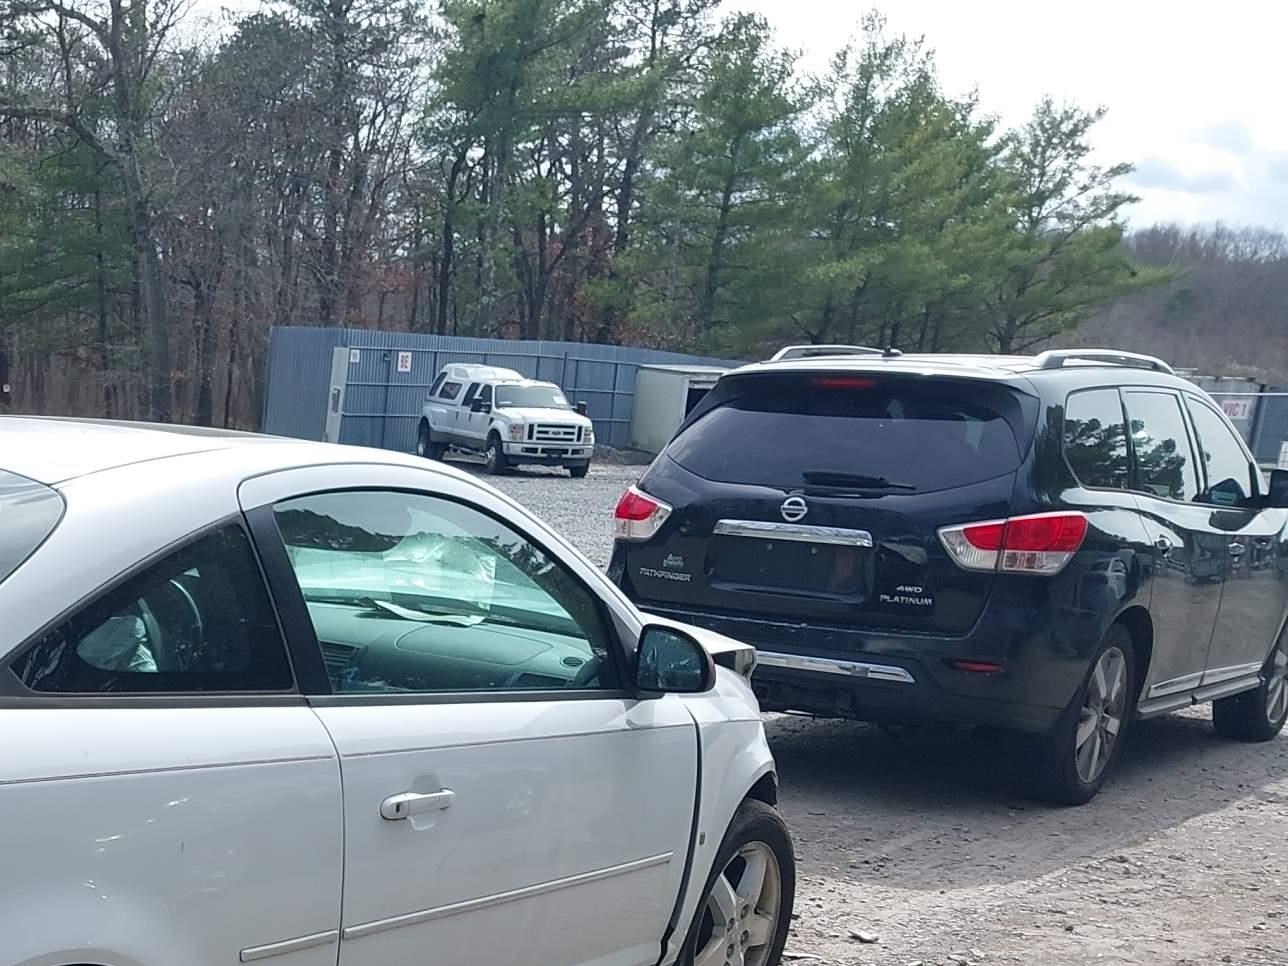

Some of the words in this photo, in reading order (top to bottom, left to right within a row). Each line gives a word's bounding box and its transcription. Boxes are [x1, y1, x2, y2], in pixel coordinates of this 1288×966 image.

[639, 567, 692, 582] PATHFINDER
[895, 585, 923, 594] 4WD
[879, 594, 933, 606] PLATINUM
